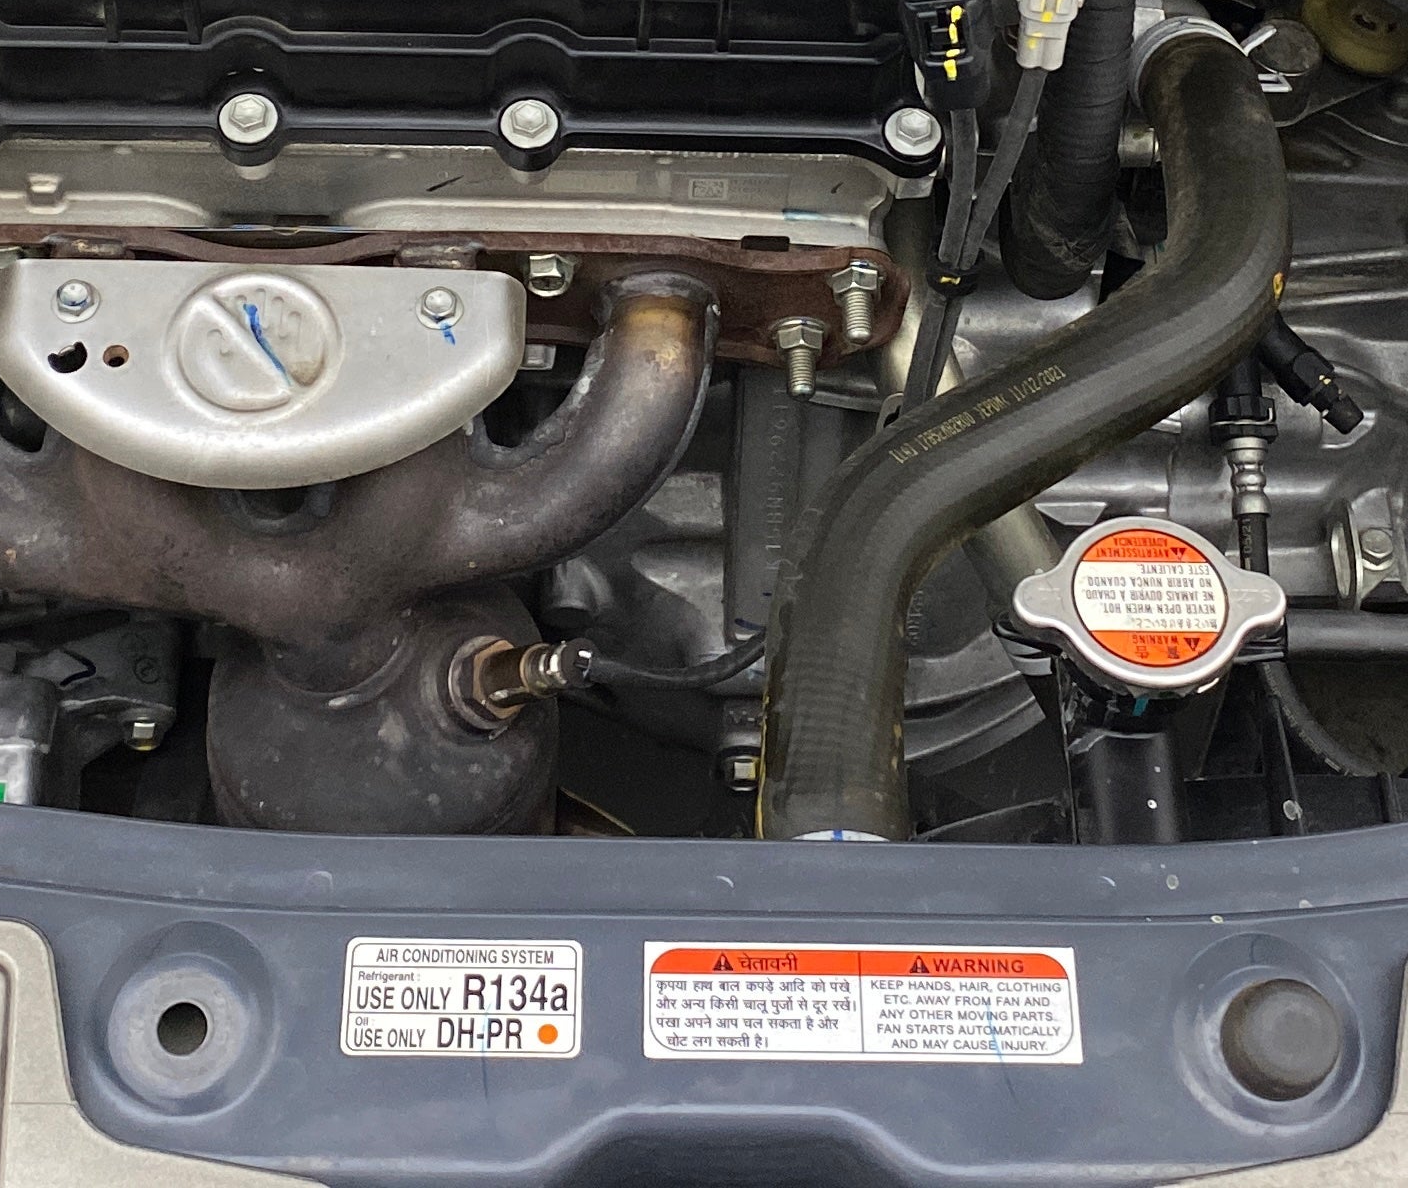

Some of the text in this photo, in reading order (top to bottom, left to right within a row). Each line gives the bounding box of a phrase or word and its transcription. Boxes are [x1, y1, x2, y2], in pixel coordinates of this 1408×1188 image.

[1113, 537, 1168, 547] ADVERTENCIA
[1096, 547, 1169, 558] AVERTISSEMENT
[1136, 564, 1209, 575] ESTE CALIENTE.
[1088, 576, 1211, 587] NO ABRIR NUNCA CUANDO
[1131, 590, 1162, 601] OUVRIR
[1166, 591, 1197, 601] JAMAIS
[1203, 592, 1214, 601] NE
[1102, 603, 1215, 614] NEVER OPEN WHEN HOT.
[1132, 635, 1178, 645] WARNING
[377, 948, 554, 965] AIR CONDITIONING SYSTEM
[738, 953, 798, 971] चेतावनी
[933, 959, 1024, 973] WARNING
[356, 973, 568, 1011] USE ONLY R134a
[656, 980, 687, 995] कृपया
[693, 980, 712, 992] हाथ
[719, 980, 740, 992] बाल
[746, 977, 774, 994] कपड़े
[779, 979, 805, 992] आदि
[811, 979, 826, 992] को
[871, 980, 1061, 993] KEEP HANDS, HAIR, CLOTHING
[656, 996, 677, 1010] और
[682, 1000, 705, 1010] अन्य
[710, 996, 739, 1010] किसी
[743, 1000, 767, 1014] चालू
[798, 998, 808, 1010] से
[813, 999, 827, 1013] दूर
[884, 995, 1050, 1007] ETC. AWAY FROM FAN AND
[879, 1010, 904, 1019] ANY
[909, 1010, 953, 1020] OTHER
[958, 1010, 1008, 1021] MOVING
[685, 1014, 711, 1029] अपने
[716, 1017, 738, 1028] आप
[743, 1018, 763, 1029] चल
[768, 1018, 801, 1029] सकता
[806, 1016, 814, 1030] है
[817, 1016, 839, 1030] और
[354, 1017, 523, 1050] USE ONLY DH-PR
[877, 1024, 1061, 1036] FAN STARTS AUTOMATICALLY
[667, 1032, 687, 1047] चोट
[692, 1036, 712, 1047] लग
[717, 1033, 750, 1048] सकती
[892, 1039, 1048, 1051] AND MAY CAUSE INJURY.
